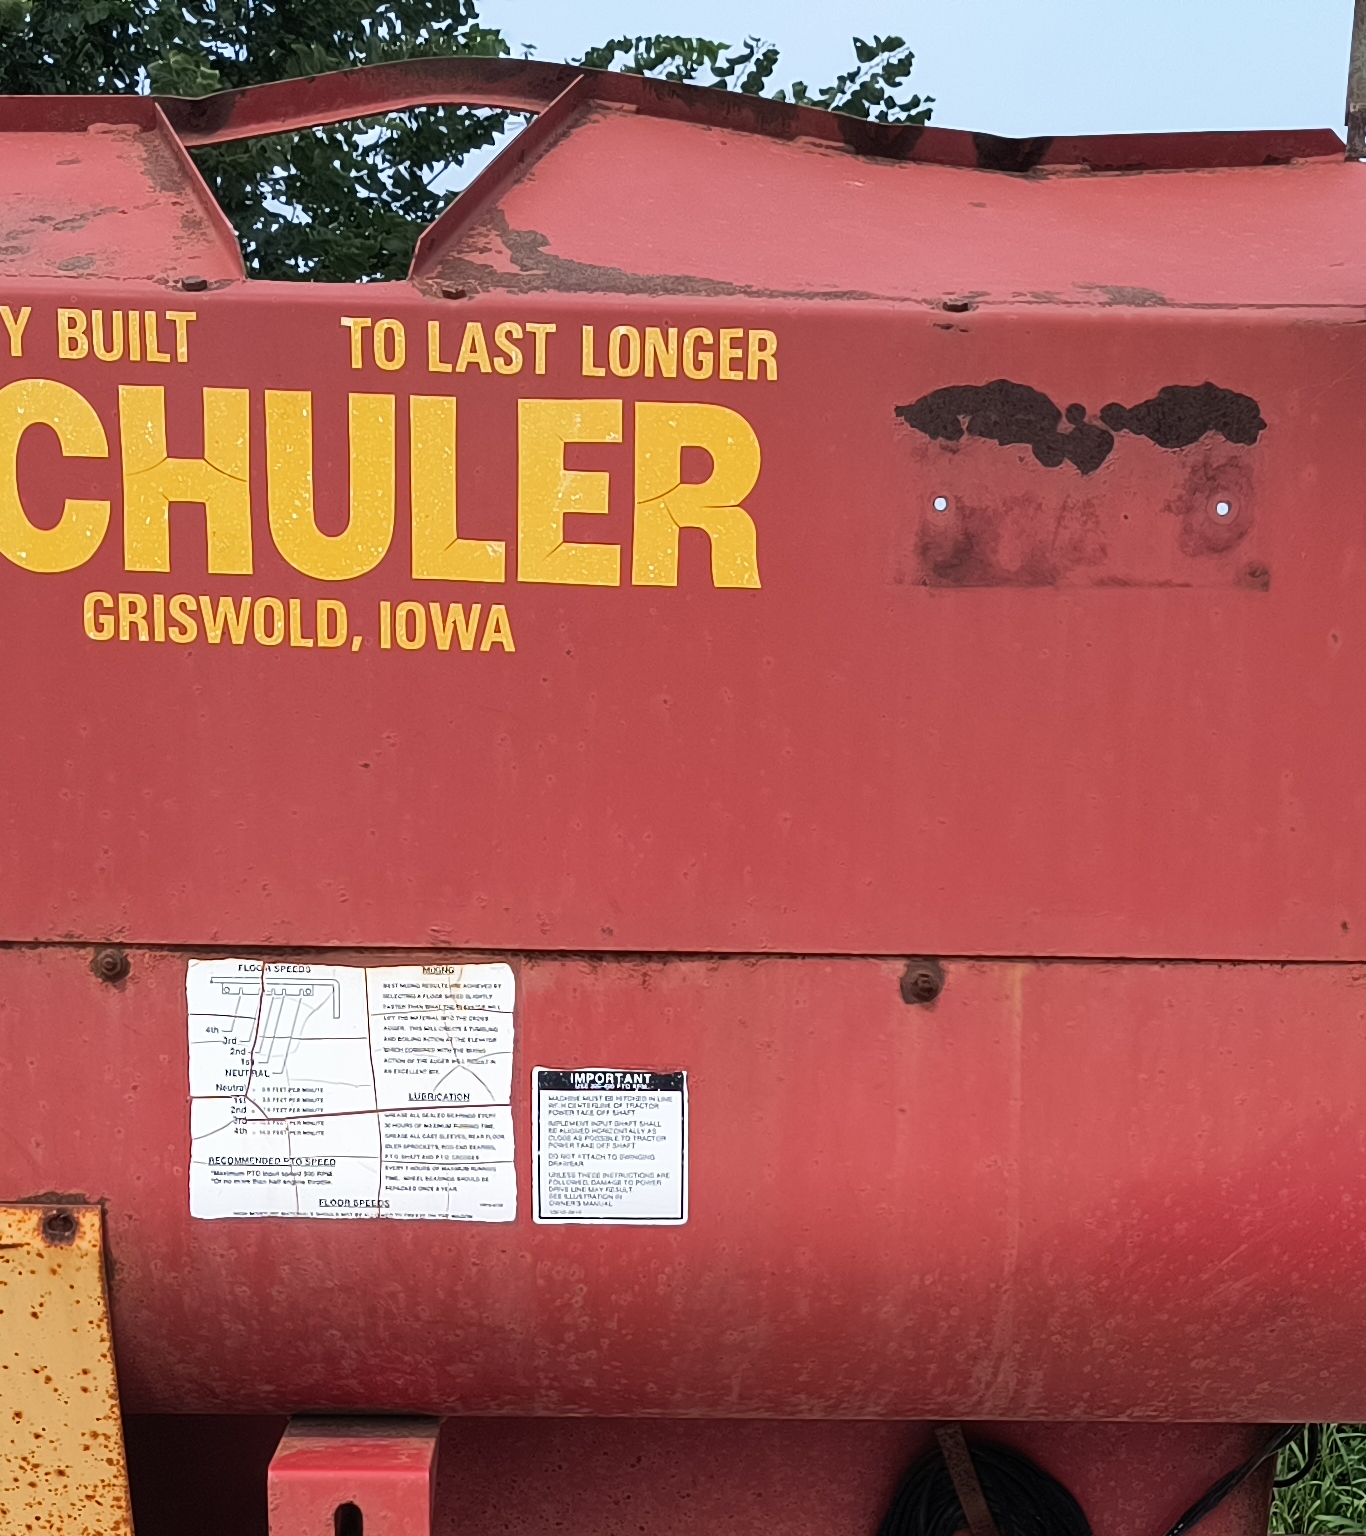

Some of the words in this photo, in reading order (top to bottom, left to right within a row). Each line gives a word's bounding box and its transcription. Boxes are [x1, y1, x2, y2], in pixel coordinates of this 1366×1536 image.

[56, 309, 198, 364] BUILT
[341, 316, 407, 372] TO
[427, 318, 557, 376] LAST
[580, 324, 779, 382] LONGER
[82, 591, 362, 654] GRISWOLD,
[379, 599, 516, 653] IOWA
[229, 1047, 246, 1056] 2nd
[571, 1072, 651, 1084] IMPORTANT
[408, 1092, 470, 1102] LUBRICATION
[230, 1105, 247, 1114] 2nd
